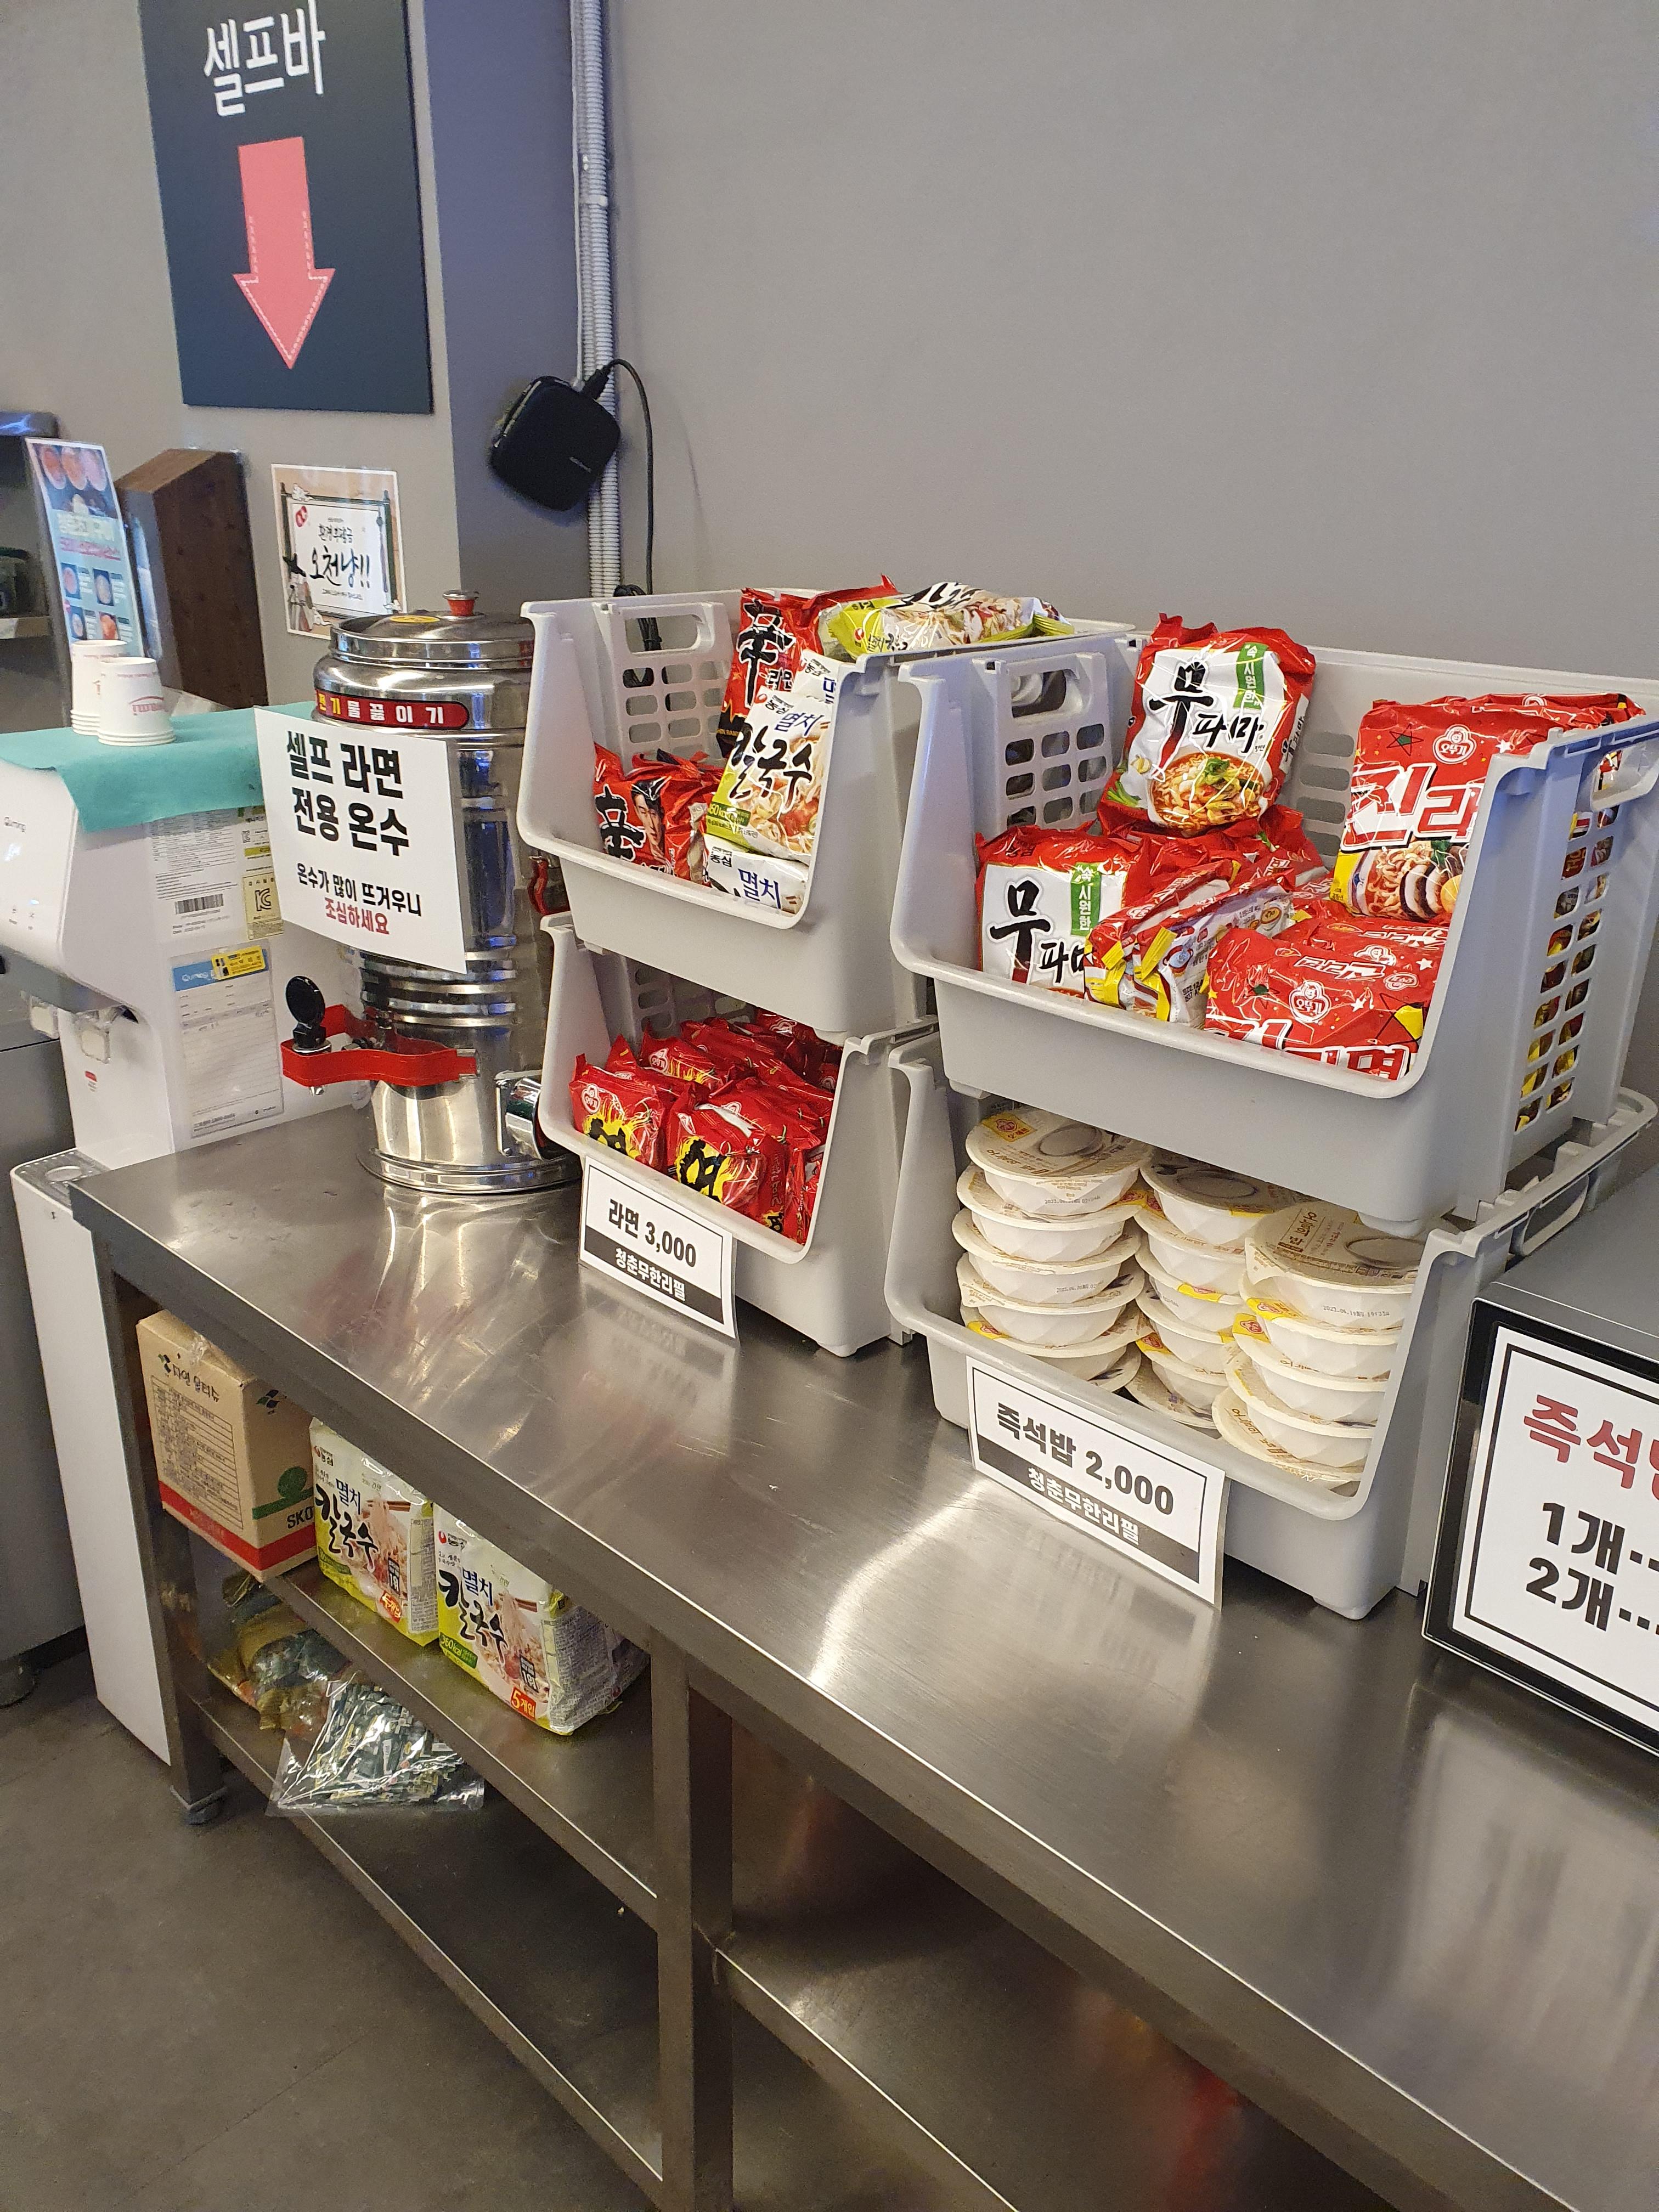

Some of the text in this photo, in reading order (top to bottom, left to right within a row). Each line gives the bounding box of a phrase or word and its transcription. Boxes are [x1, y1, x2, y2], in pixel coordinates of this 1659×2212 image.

[203, 0, 326, 116] 셀프바
[774, 713, 824, 737] 멸치
[286, 730, 403, 799] 셀프 라면
[729, 723, 813, 810] 칼국수
[291, 787, 409, 857] 전용 온수
[297, 862, 422, 917] 온수가 많이 뜨거우니
[325, 896, 390, 935] 조심하세요
[737, 868, 781, 910] 멸치
[608, 1198, 696, 1267] 라면 3,000
[615, 1247, 686, 1302] 청춘무한리필
[997, 1402, 1174, 1516] 즉석밥 2,000
[1523, 1394, 1659, 1502] 즉석
[287, 1505, 314, 1529] SKO
[315, 1483, 379, 1572] 칼국수
[336, 1478, 361, 1515] 멸치
[1028, 1466, 1139, 1545] 청춘무한리필
[438, 1568, 509, 1664] 칼국수
[462, 1567, 493, 1606] 멸치
[511, 1690, 535, 1718] 5개입
